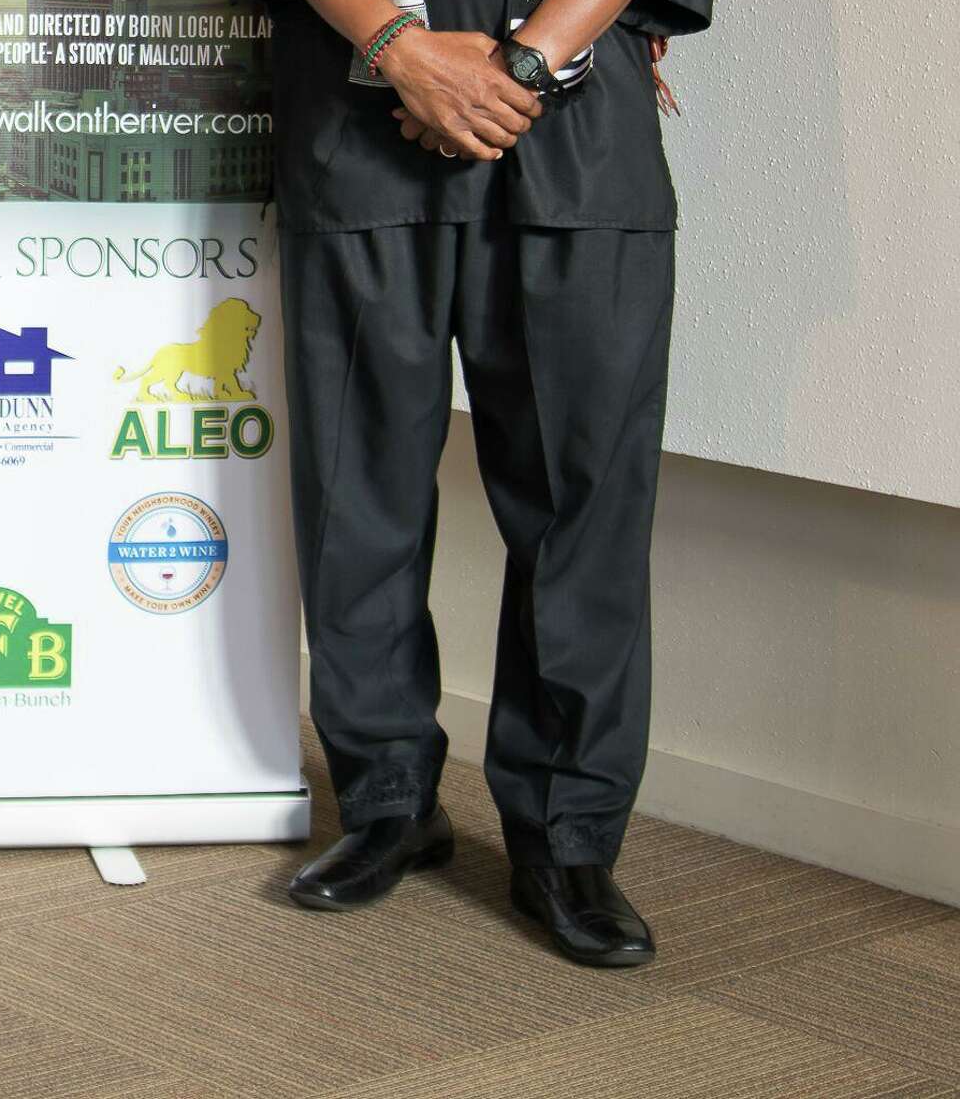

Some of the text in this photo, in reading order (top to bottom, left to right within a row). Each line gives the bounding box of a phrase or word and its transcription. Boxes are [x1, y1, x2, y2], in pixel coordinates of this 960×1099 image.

[29, 14, 101, 37] DIRECTED
[105, 14, 125, 37] BY
[129, 15, 173, 38] BORN
[178, 15, 224, 38] LOGIC
[55, 43, 66, 65] A
[69, 43, 115, 66] STORY
[118, 43, 136, 66] OF
[139, 44, 210, 67] MALCOLM
[16, 237, 257, 279] SPONSORS
[0, 398, 54, 418] DUNN
[3, 422, 54, 434] Agency
[109, 404, 274, 460] ALEO
[4, 442, 54, 452] Commercial
[132, 496, 199, 516] NEIGHBORHOOD
[200, 507, 220, 536] WINERY
[146, 600, 168, 611] YOUR
[170, 597, 192, 611] OWN
[15, 691, 72, 708] Bunch
